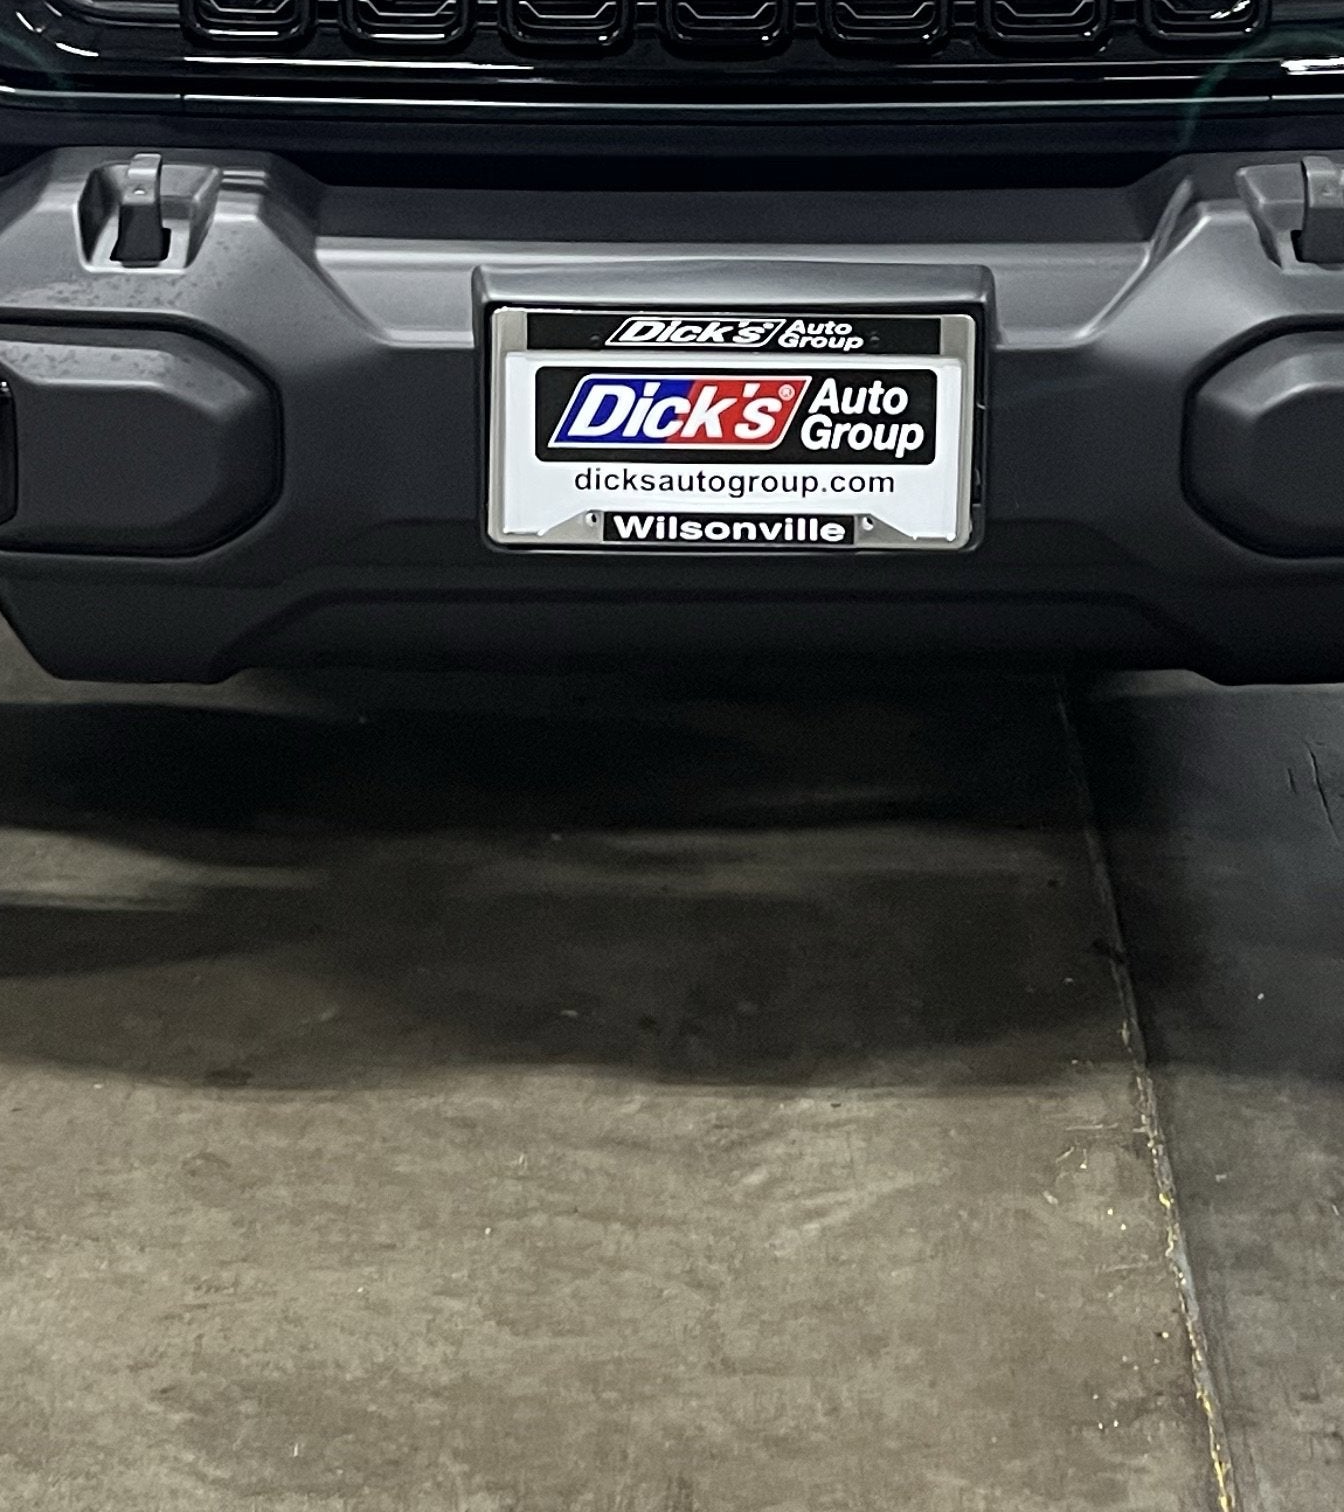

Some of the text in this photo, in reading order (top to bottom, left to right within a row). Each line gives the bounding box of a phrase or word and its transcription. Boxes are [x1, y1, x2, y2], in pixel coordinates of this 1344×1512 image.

[618, 319, 766, 345] Dick's
[777, 332, 865, 352] Group
[784, 319, 853, 336] Auto
[567, 382, 783, 440] Dick's
[808, 377, 909, 416] Auto
[800, 413, 925, 459] Group
[574, 467, 895, 498] dicksautogroup.com
[613, 515, 846, 542] Wilsonville
